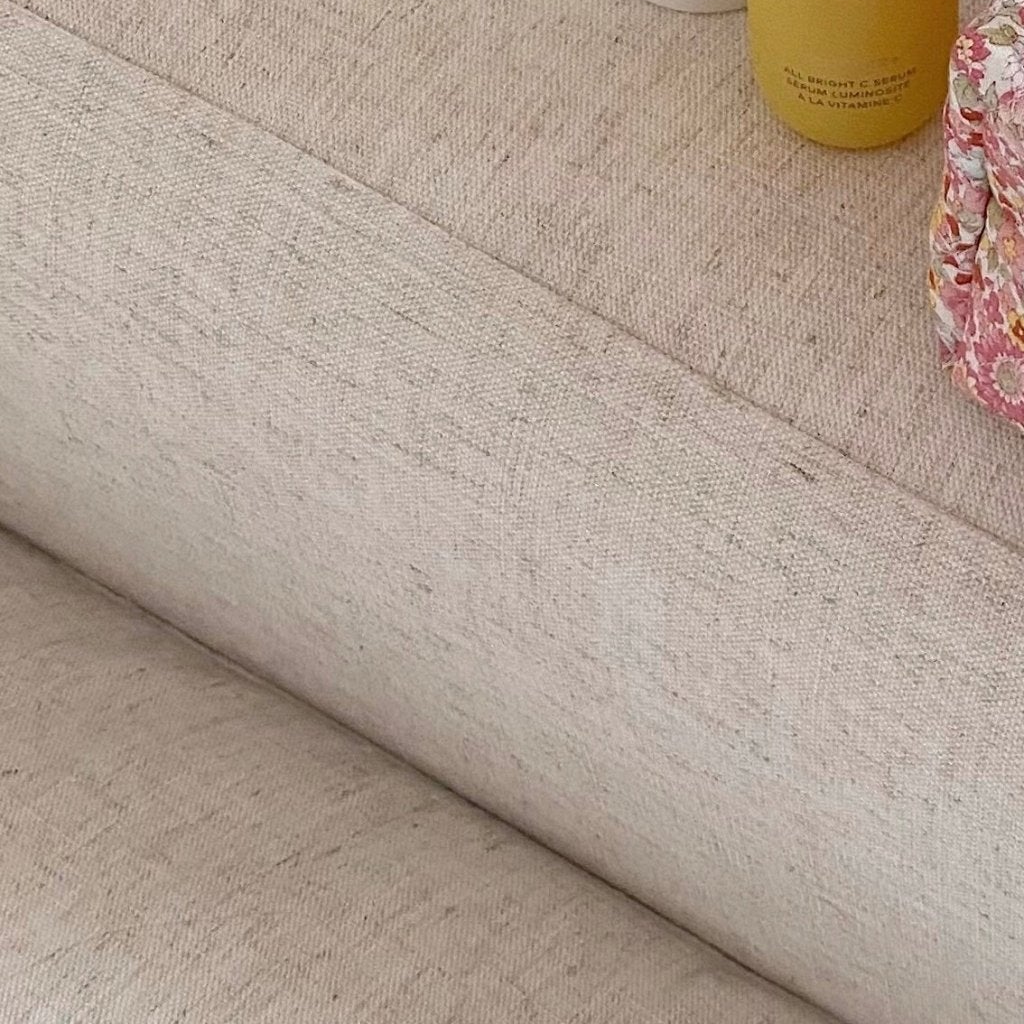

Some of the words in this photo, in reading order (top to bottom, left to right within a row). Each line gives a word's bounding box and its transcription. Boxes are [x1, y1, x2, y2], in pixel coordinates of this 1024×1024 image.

[784, 66, 803, 79] ALL
[808, 76, 854, 88] BRIGHT
[860, 80, 868, 88] C
[874, 67, 916, 86] SERUM
[809, 96, 824, 106] LA
[828, 98, 891, 109] VITAMINE
